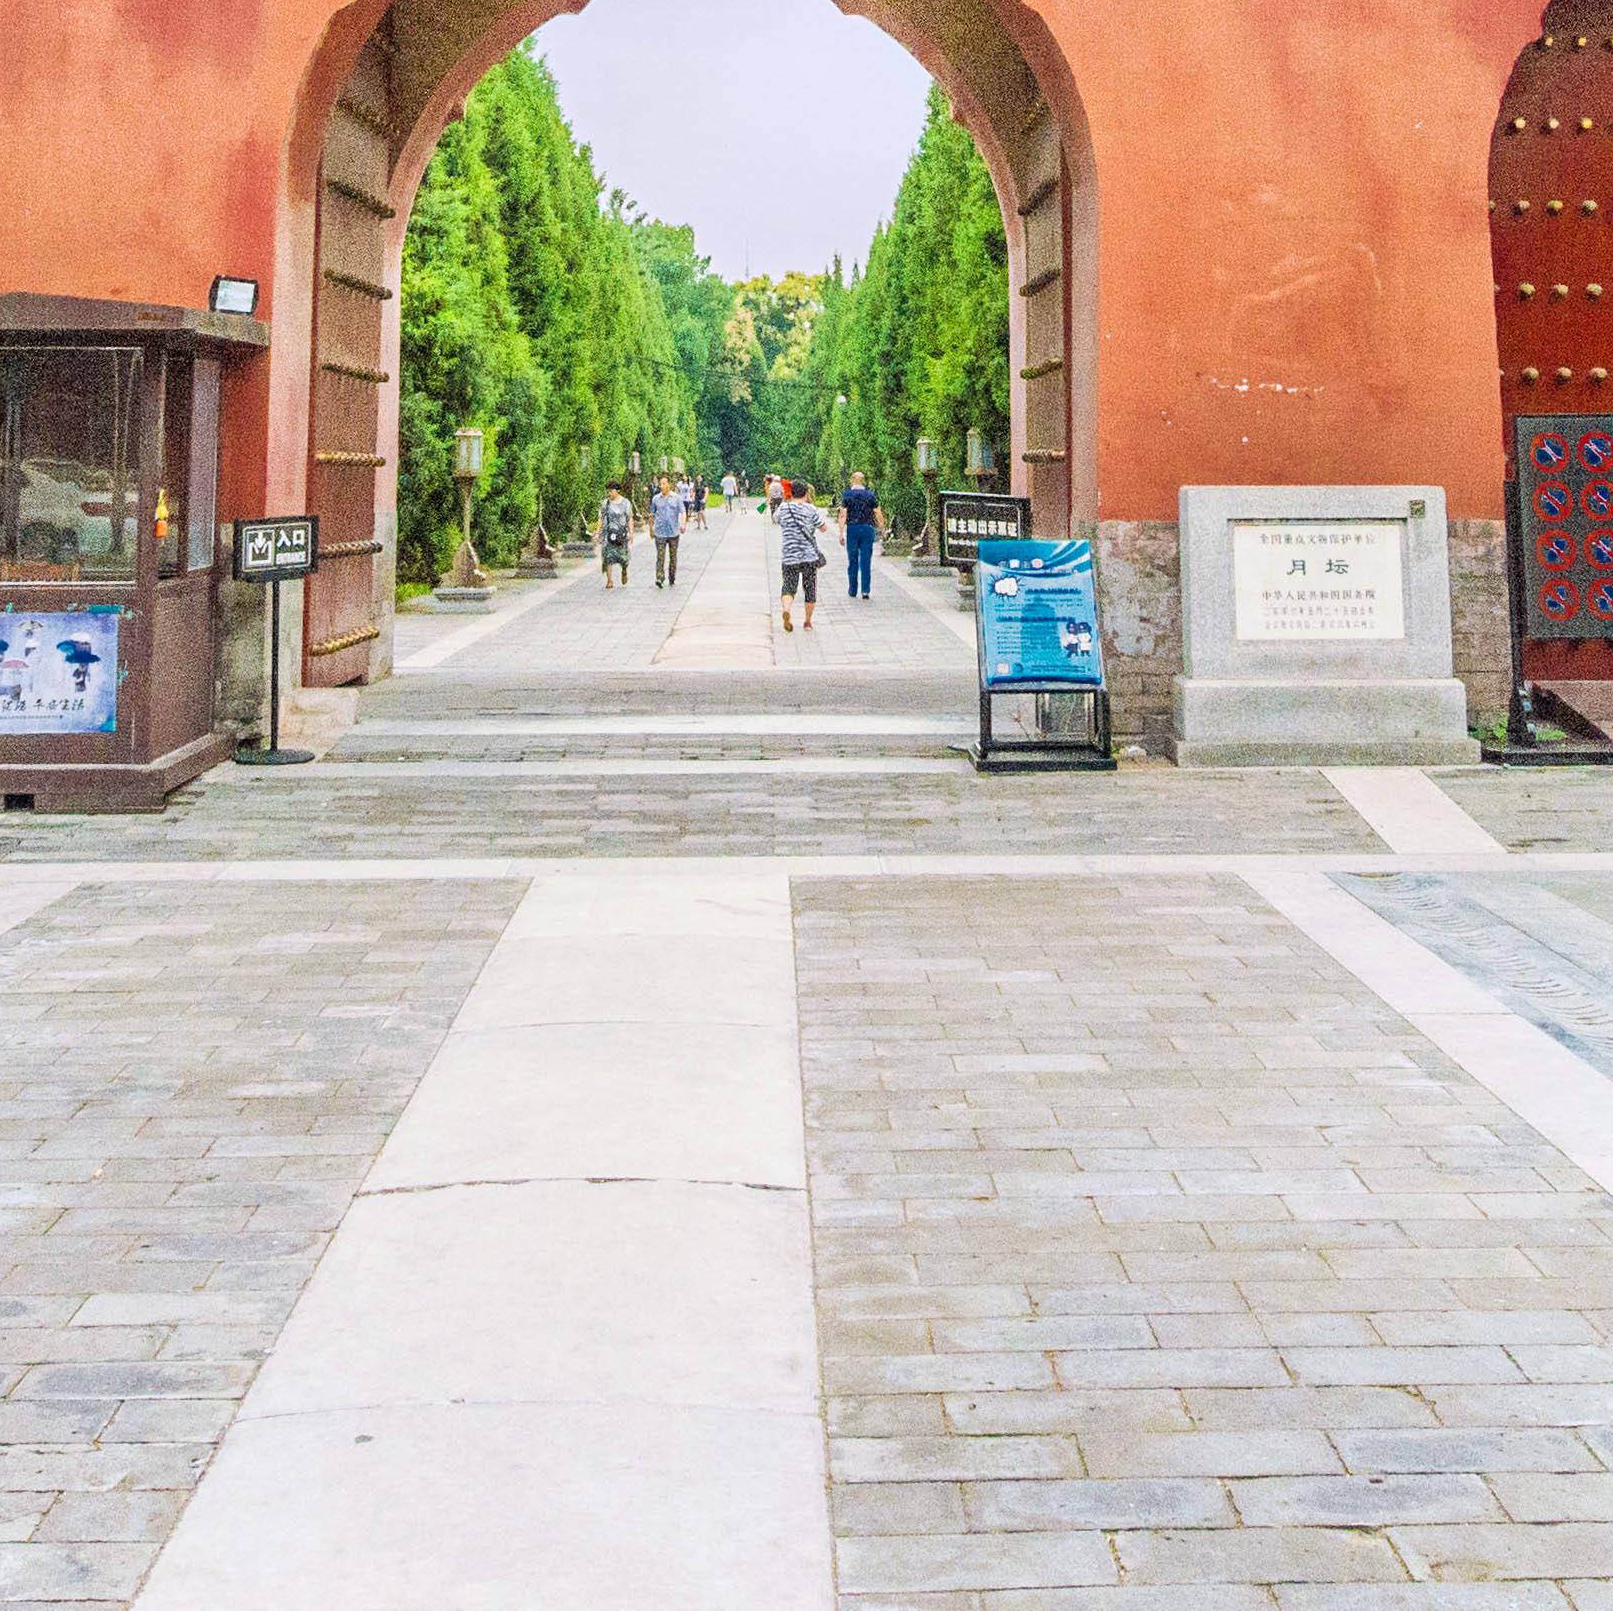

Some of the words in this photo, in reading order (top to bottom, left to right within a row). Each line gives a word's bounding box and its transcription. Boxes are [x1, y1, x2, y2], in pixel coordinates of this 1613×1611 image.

[276, 530, 306, 548] 入口
[1260, 533, 1376, 545] 全国重点文物保护单位
[1287, 558, 1350, 576] 月坛
[1262, 589, 1376, 601] 中华人民共和国国务院
